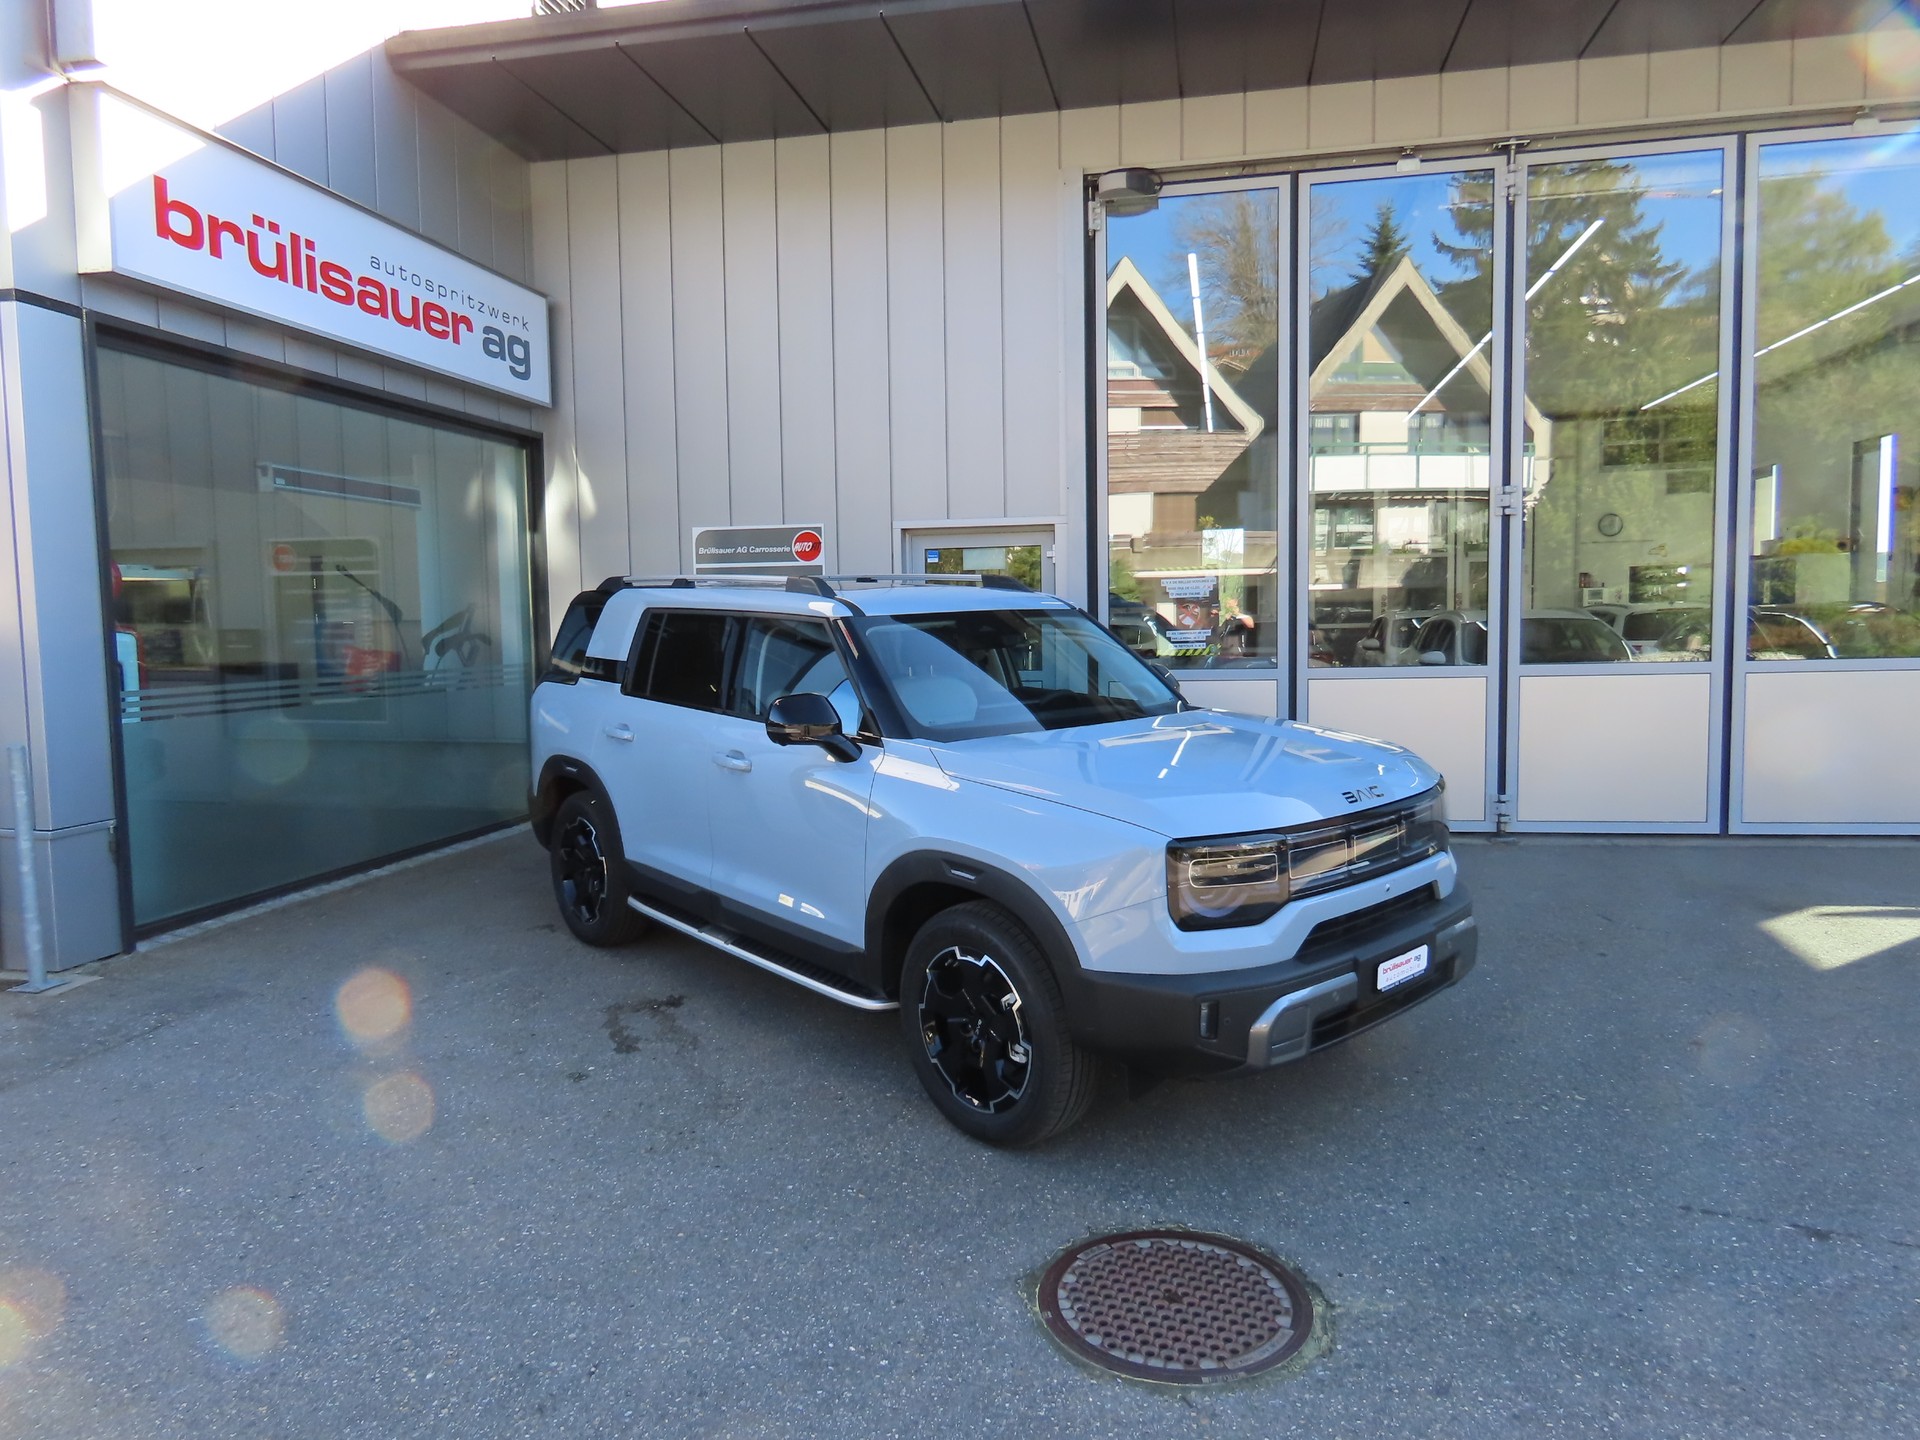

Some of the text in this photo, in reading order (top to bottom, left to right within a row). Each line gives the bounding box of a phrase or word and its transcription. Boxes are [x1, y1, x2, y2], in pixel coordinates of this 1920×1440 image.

[154, 174, 532, 381] brülisauer ag
[370, 255, 529, 333] autospritzwerk
[698, 545, 791, 555] Brülisauer AG Carrosserie
[1341, 785, 1385, 804] BAIC
[1413, 954, 1422, 962] ag
